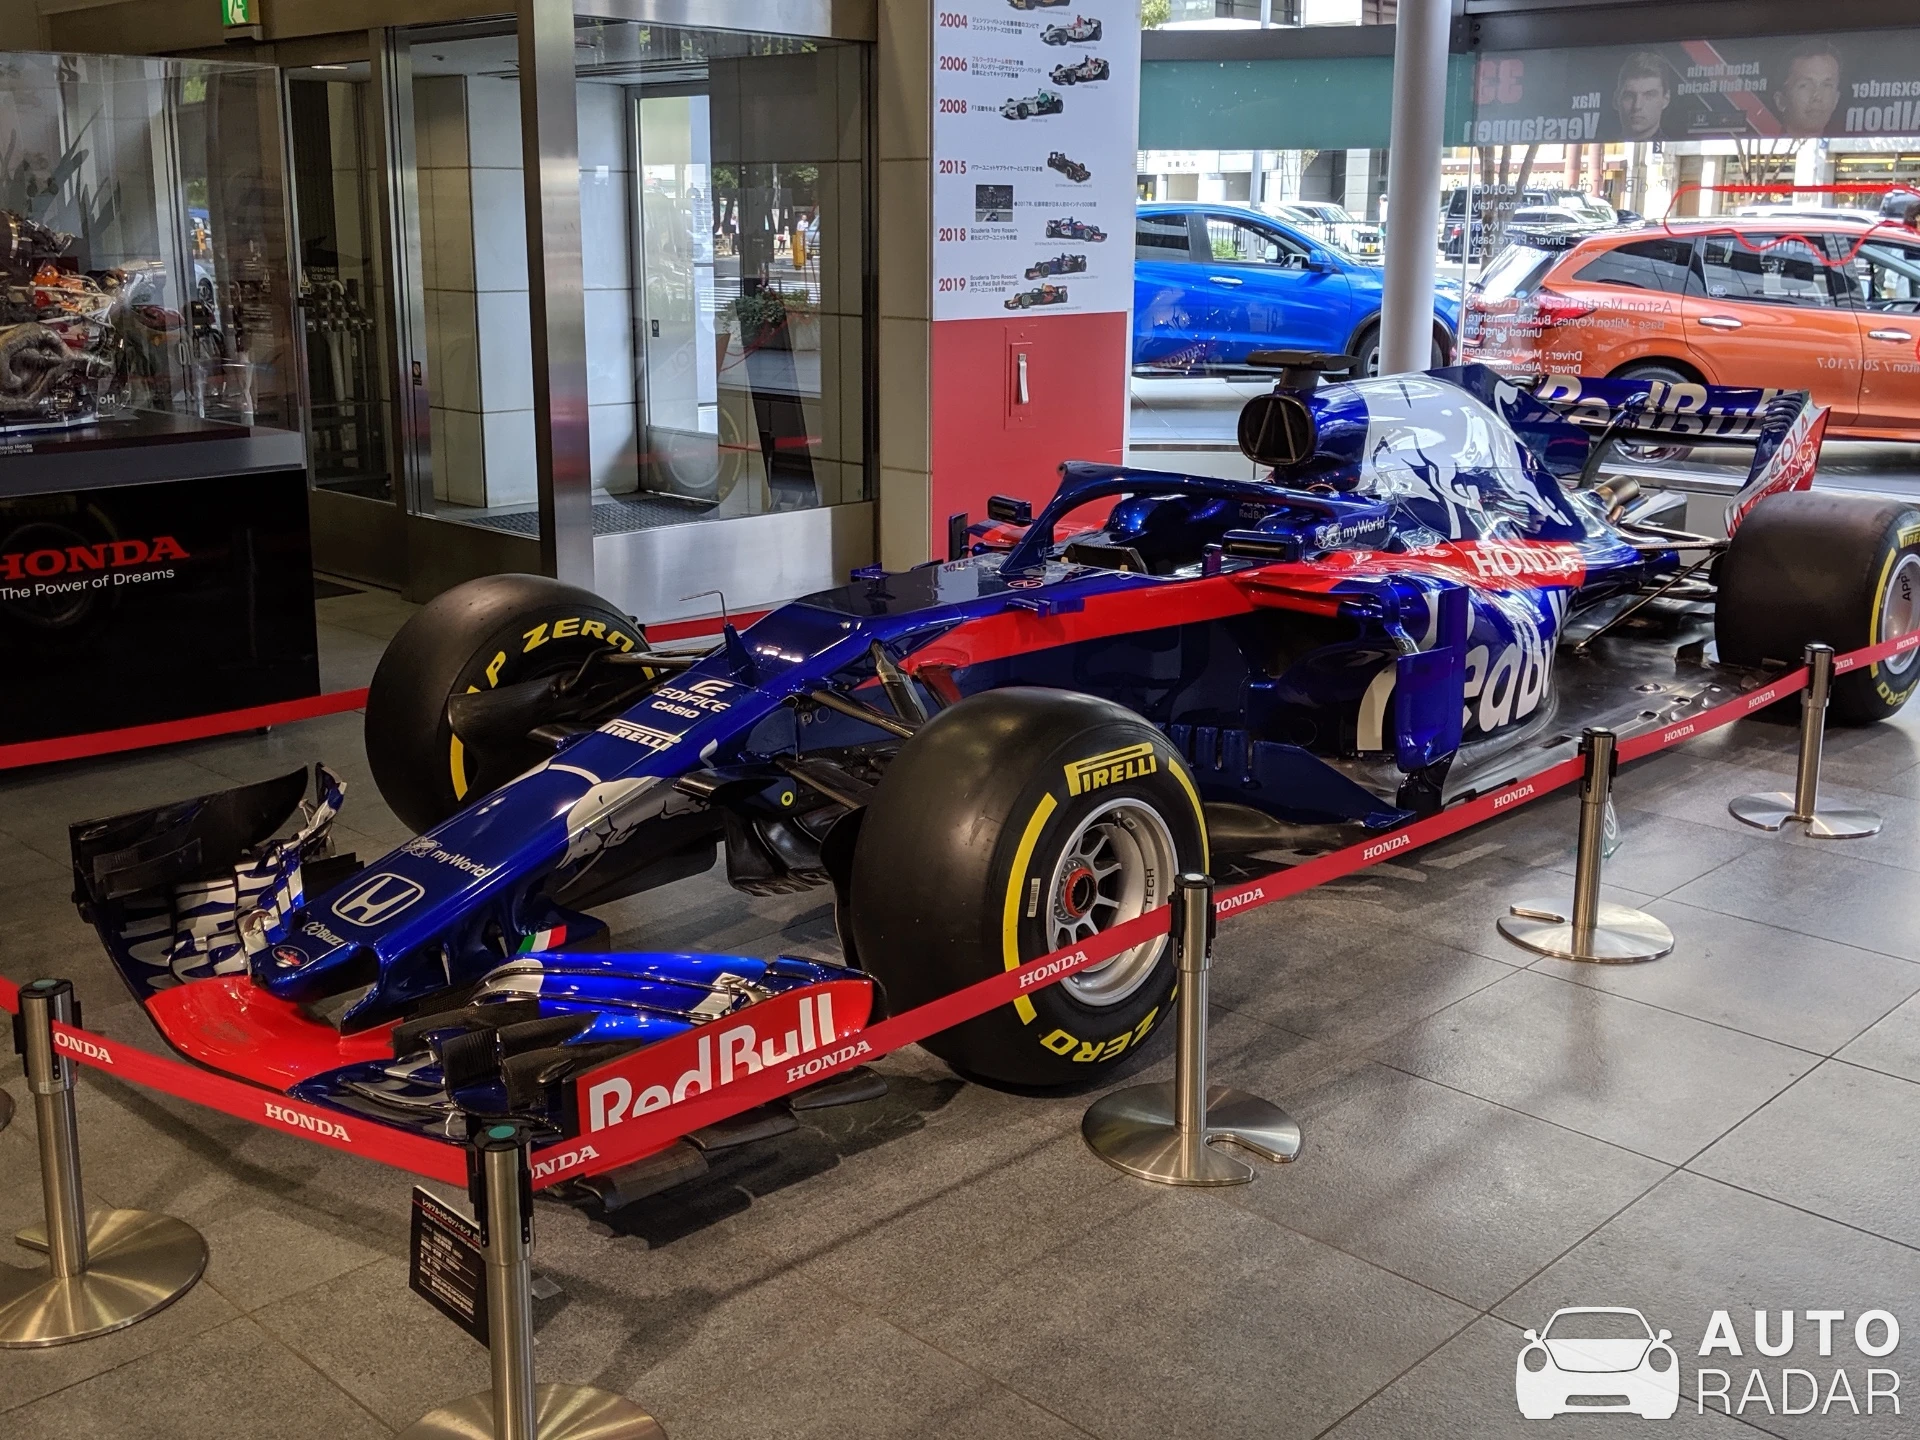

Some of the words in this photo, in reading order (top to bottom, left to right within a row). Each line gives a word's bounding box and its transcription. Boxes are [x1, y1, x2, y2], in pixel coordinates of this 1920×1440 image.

[940, 12, 968, 29] 2004
[940, 56, 967, 71] 2006
[939, 98, 967, 114] 2008
[939, 160, 967, 174] 2015
[939, 227, 966, 241] 2018
[938, 277, 966, 292] 2019
[1343, 516, 1385, 539] myWorld
[0, 536, 190, 580] HONDA
[1465, 544, 1580, 578] HONDA
[0, 587, 31, 600] The
[35, 580, 88, 596] Power
[92, 574, 109, 588] of
[114, 569, 175, 585] Dreams
[486, 651, 506, 688] P
[523, 617, 635, 653] ZERO
[1896, 636, 1918, 650] HONDA
[1835, 658, 1854, 669] ONDA
[651, 701, 700, 719] CASIO
[653, 687, 731, 713] EDIFICE
[1748, 690, 1776, 708] HONDA
[596, 718, 682, 751] PIRELLI
[1664, 724, 1695, 742] HONDA
[1064, 742, 1158, 797] PIRELLI
[1493, 784, 1535, 809] HONDA
[1363, 834, 1411, 860] HONDA
[430, 850, 491, 878] myWorld
[1019, 951, 1088, 989] HONDA
[1040, 1006, 1159, 1063] ZERO
[53, 1031, 114, 1065] ONDA
[787, 1040, 873, 1084] HONDA
[265, 1102, 351, 1143] HONDA
[531, 1145, 599, 1180] NDA
